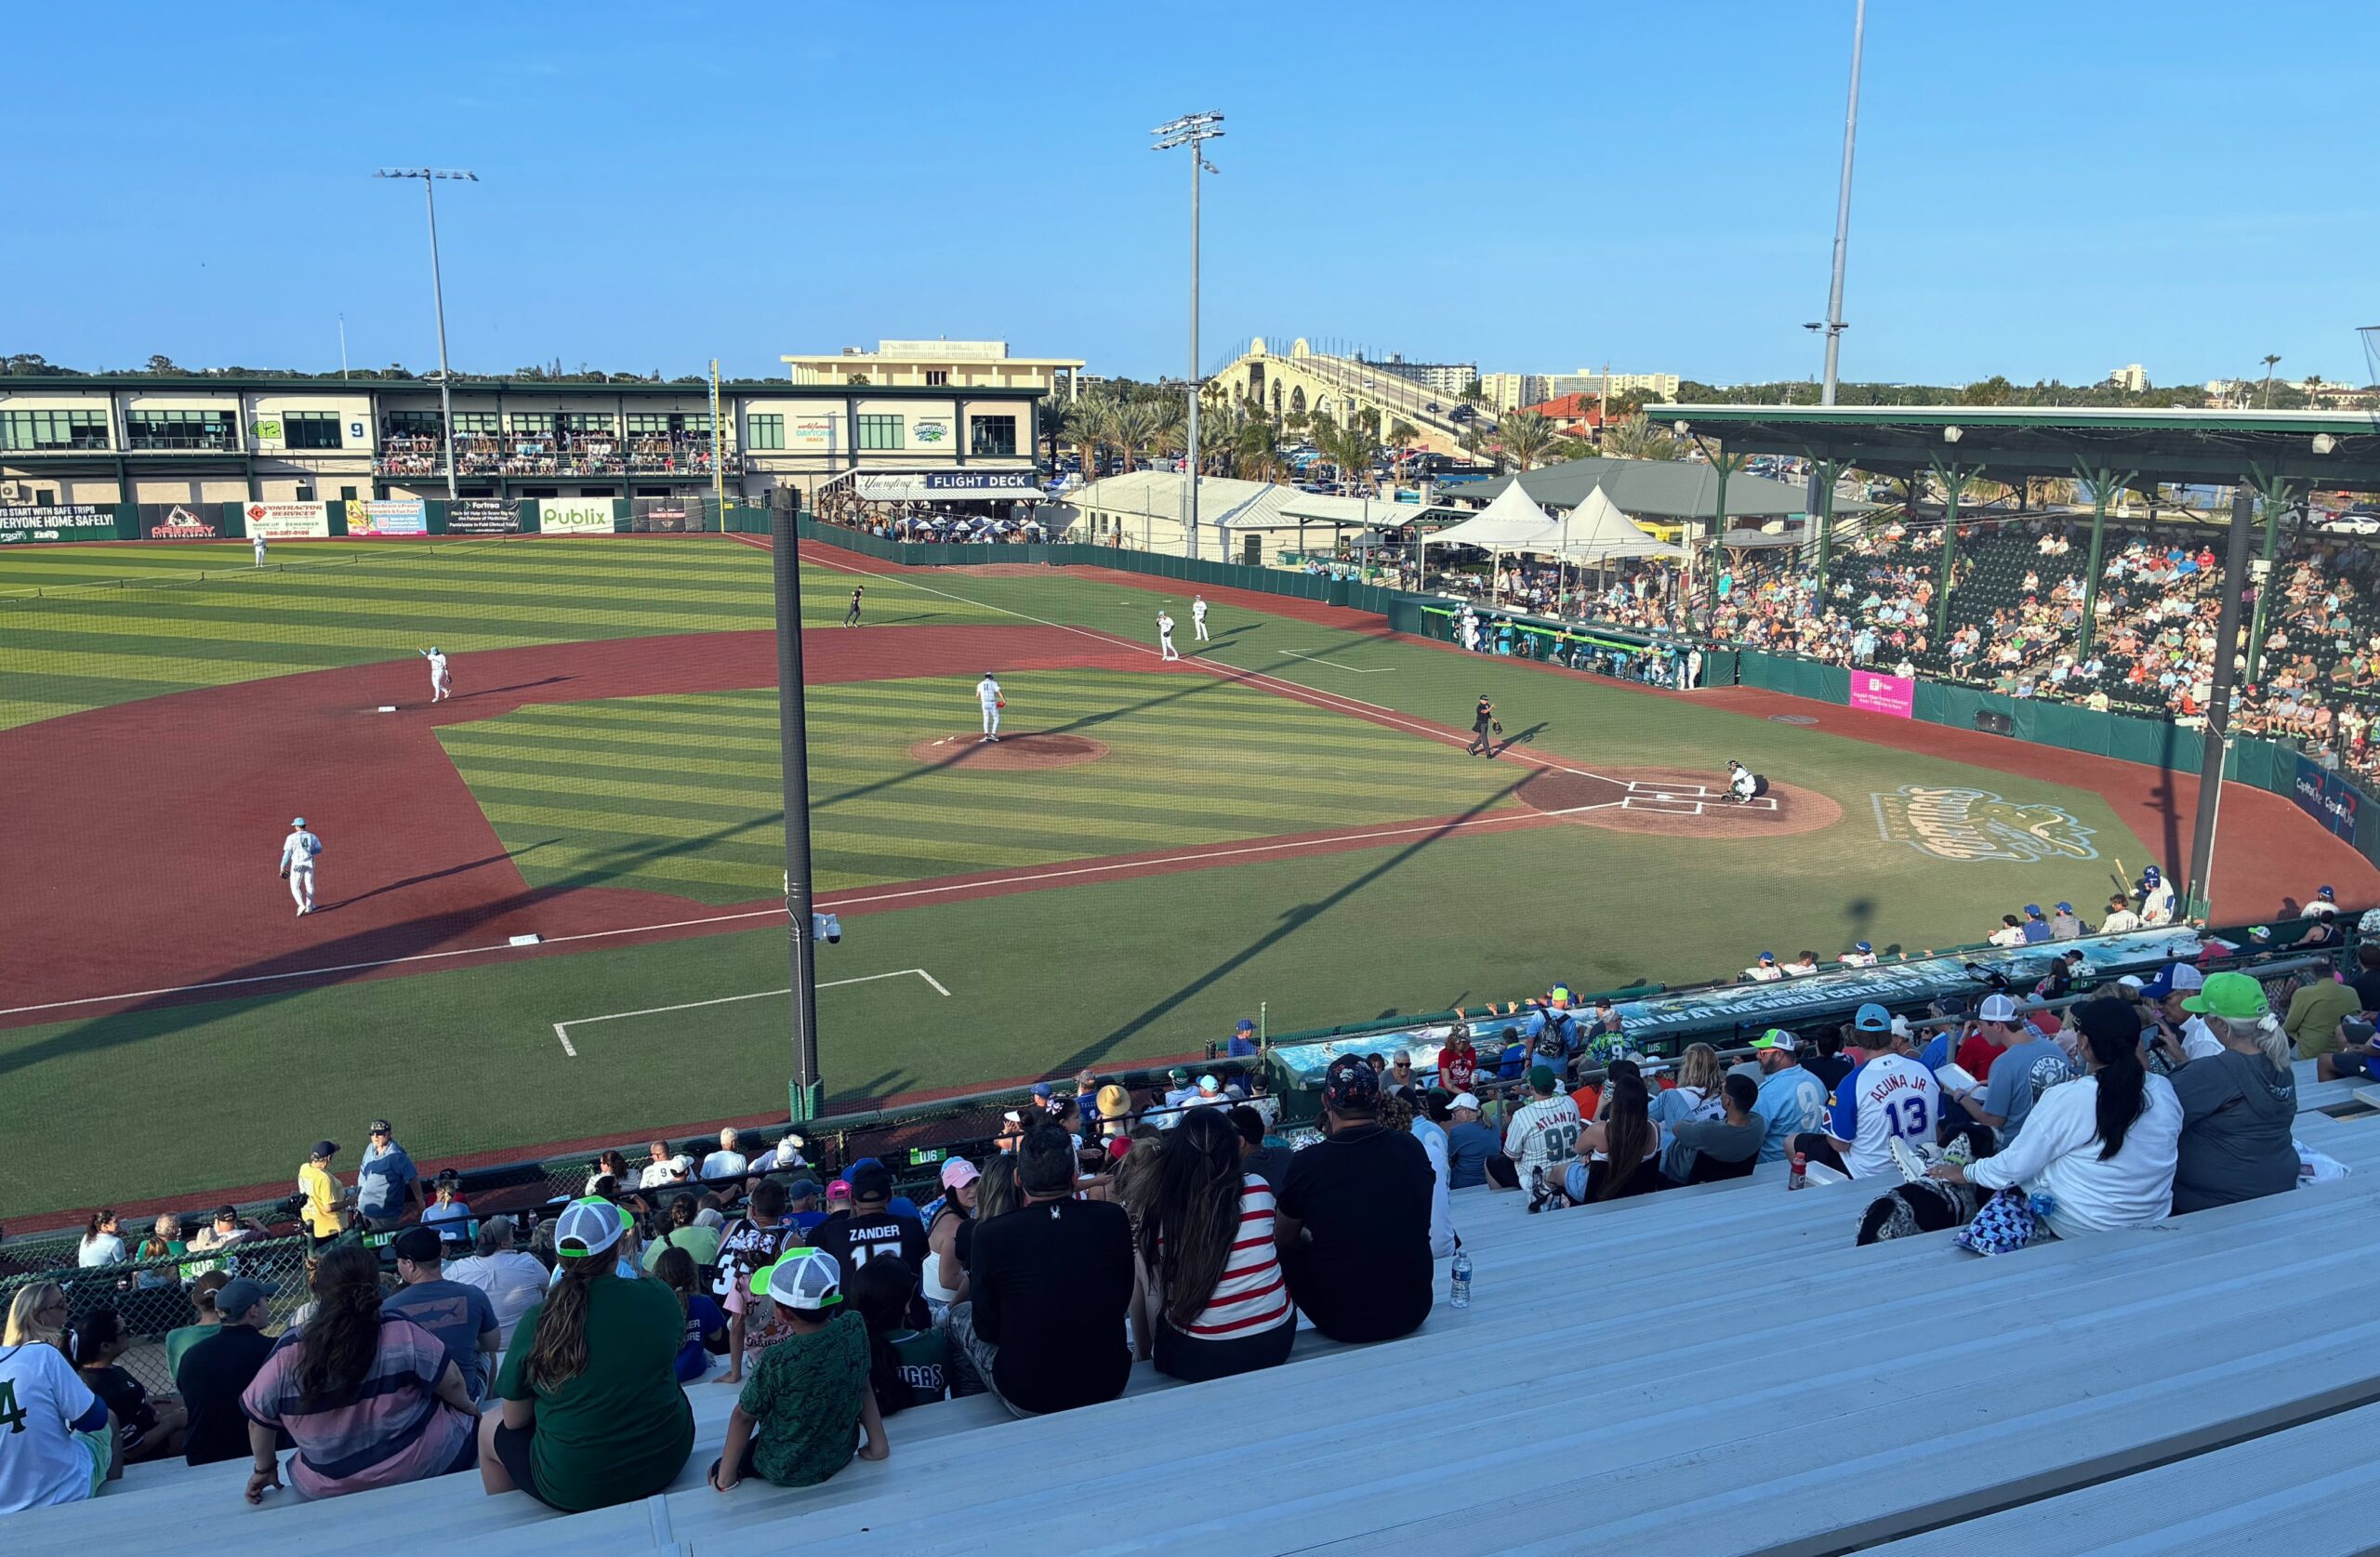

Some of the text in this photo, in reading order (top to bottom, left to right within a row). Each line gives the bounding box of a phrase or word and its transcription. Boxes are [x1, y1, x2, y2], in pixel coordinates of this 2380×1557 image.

[249, 420, 282, 439] 42
[350, 423, 364, 438] 9
[860, 476, 914, 490] Yuengling
[933, 475, 1026, 488] FLIGHT DECK
[9, 508, 33, 517] START
[33, 507, 53, 516] WITH
[54, 507, 72, 515] SAFE
[73, 506, 96, 514] TRIPS
[544, 508, 605, 524] Publix
[45, 516, 74, 528] HOME
[75, 514, 113, 527] SAFELY!
[1658, 1011, 1688, 1023] US
[1686, 1007, 1716, 1019] AT
[1714, 1000, 1760, 1015] THE
[1757, 992, 1828, 1009] WORLD
[1826, 981, 1904, 999] CENTER
[1898, 976, 1925, 988] OF
[1611, 1044, 1623, 1061] 9
[1647, 1042, 1661, 1053] W5
[2031, 1057, 2066, 1077] ROCKY
[1871, 1074, 1927, 1103] ACUÑA JR.
[1797, 1081, 1820, 1130] 9
[1536, 1111, 1577, 1131] ATLANTA
[1884, 1095, 1928, 1140] 13
[1544, 1124, 1578, 1162] 93
[919, 1150, 937, 1163] W6
[661, 1168, 667, 1178] 9
[959, 1165, 971, 1174] NY
[849, 1224, 901, 1242] ZANDER
